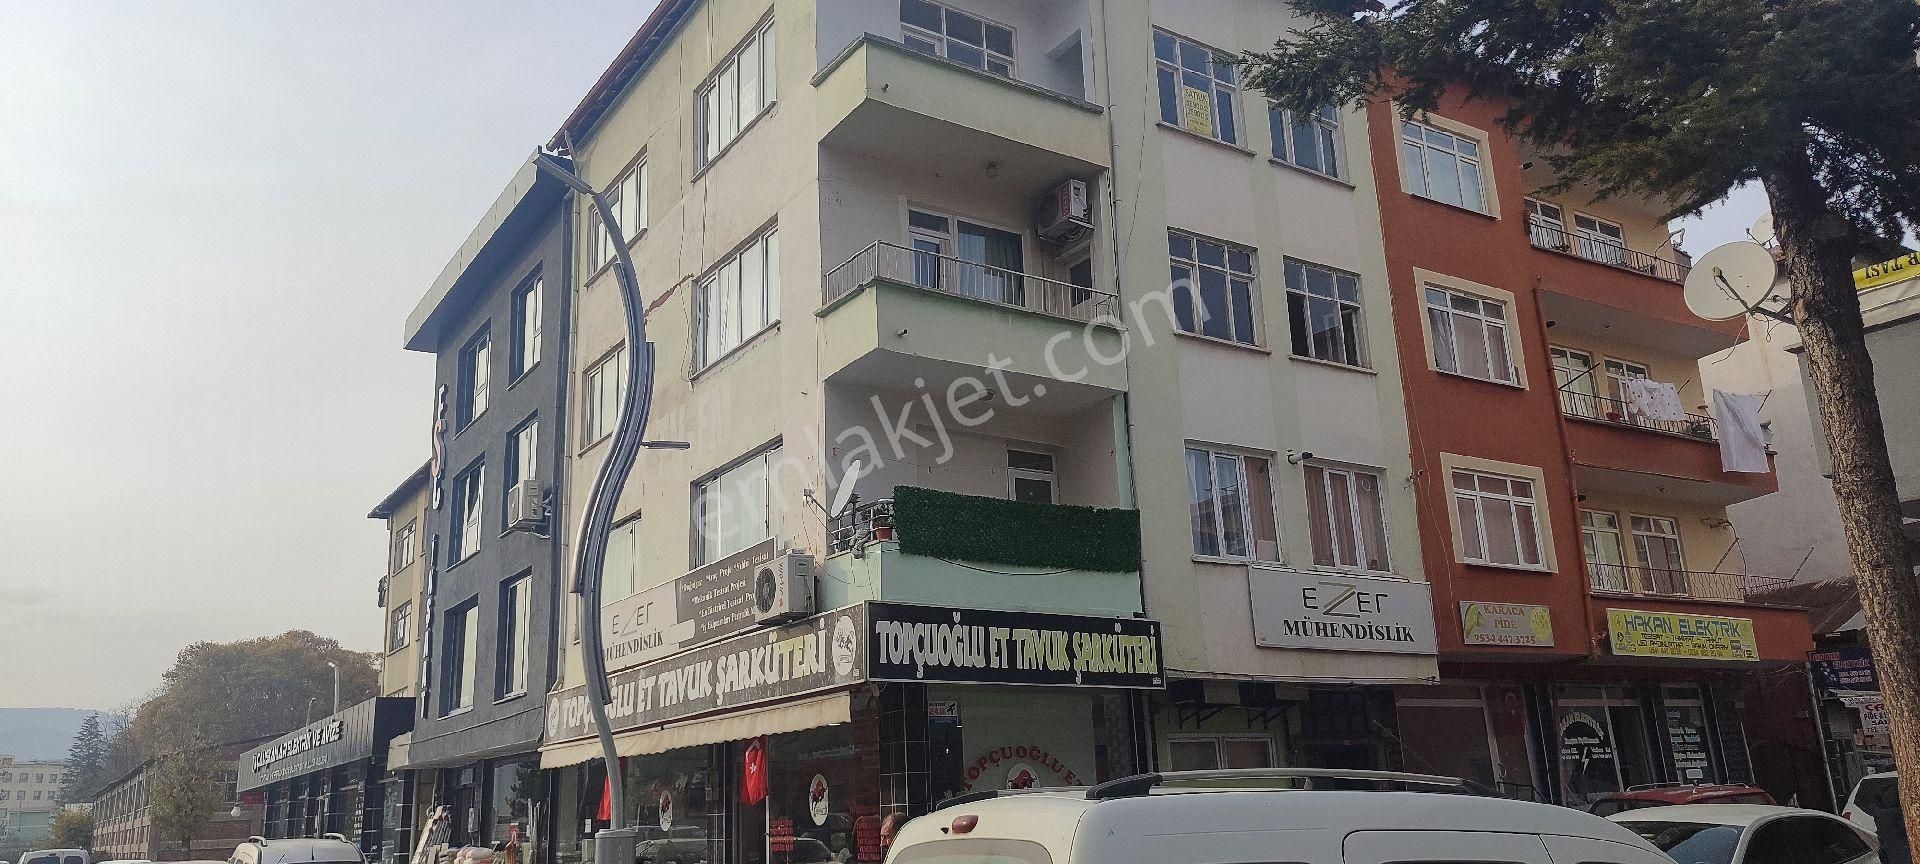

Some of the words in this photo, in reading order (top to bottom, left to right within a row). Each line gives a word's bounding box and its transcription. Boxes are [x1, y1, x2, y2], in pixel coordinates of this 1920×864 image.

[1484, 604, 1525, 617] KARACA
[1493, 616, 1517, 630] PİDE
[1283, 615, 1415, 643] MÜHENDİSLİK
[1624, 614, 1673, 634] HAKAN
[1679, 617, 1741, 639] ELEKTRİK
[876, 611, 986, 679] TOPÇUOĞLU
[988, 626, 1010, 669] ET
[1012, 628, 1071, 672] TAVUK
[1073, 622, 1158, 685] ŞARKÜTERİ
[637, 674, 658, 714] ET
[657, 659, 713, 709] TAVUK
[715, 617, 827, 705] ŞARKÜTERİ
[962, 746, 1065, 792] TOPÇUOĞLU
